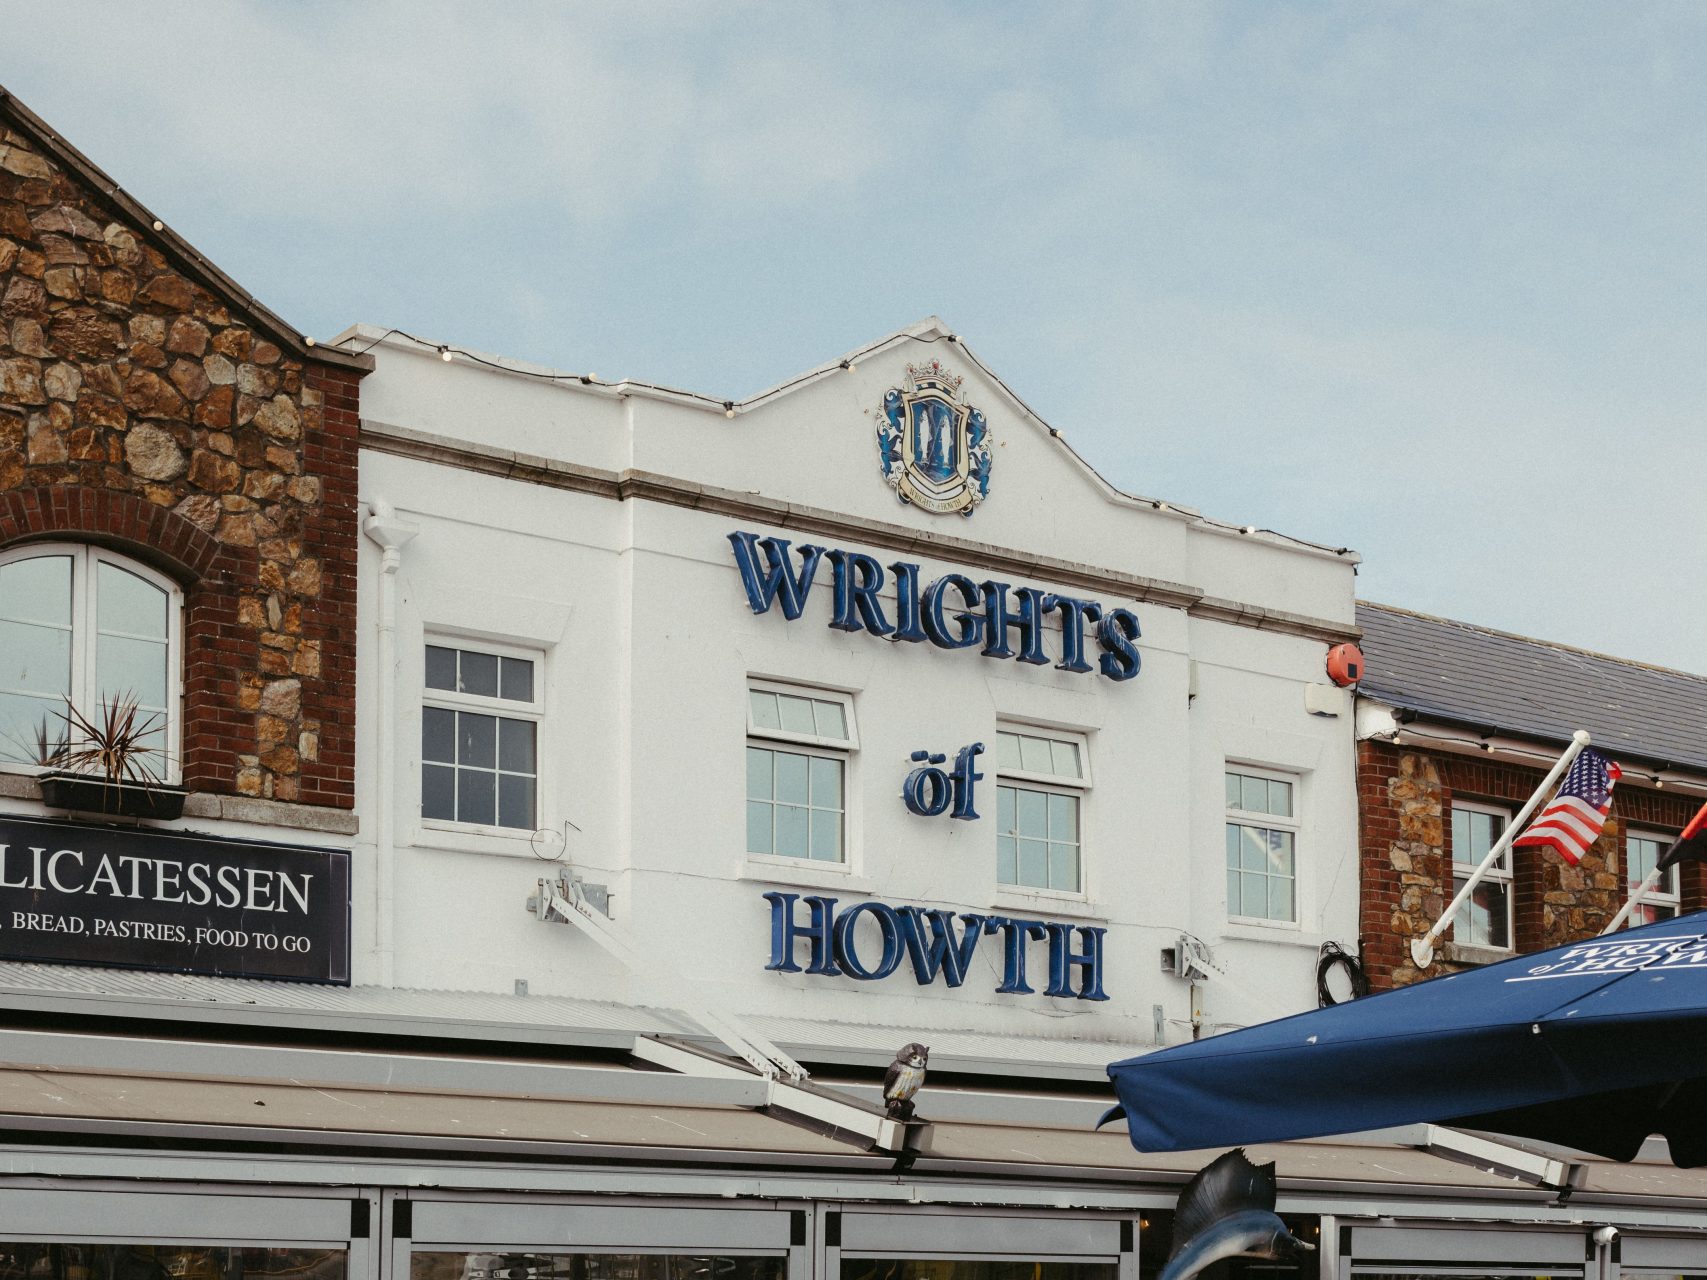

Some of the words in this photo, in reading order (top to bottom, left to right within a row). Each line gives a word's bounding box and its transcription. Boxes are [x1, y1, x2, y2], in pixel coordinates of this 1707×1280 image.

[727, 530, 1141, 681] WRIGHTS
[0, 844, 313, 915] LICATESSEN
[12, 911, 90, 938] BREAD,
[94, 918, 191, 945] PASTRIES,
[196, 928, 248, 948] FOOD
[252, 933, 278, 950] TO
[282, 935, 311, 953] GO
[763, 891, 1110, 1001] HOWTH
[1528, 960, 1577, 975] of
